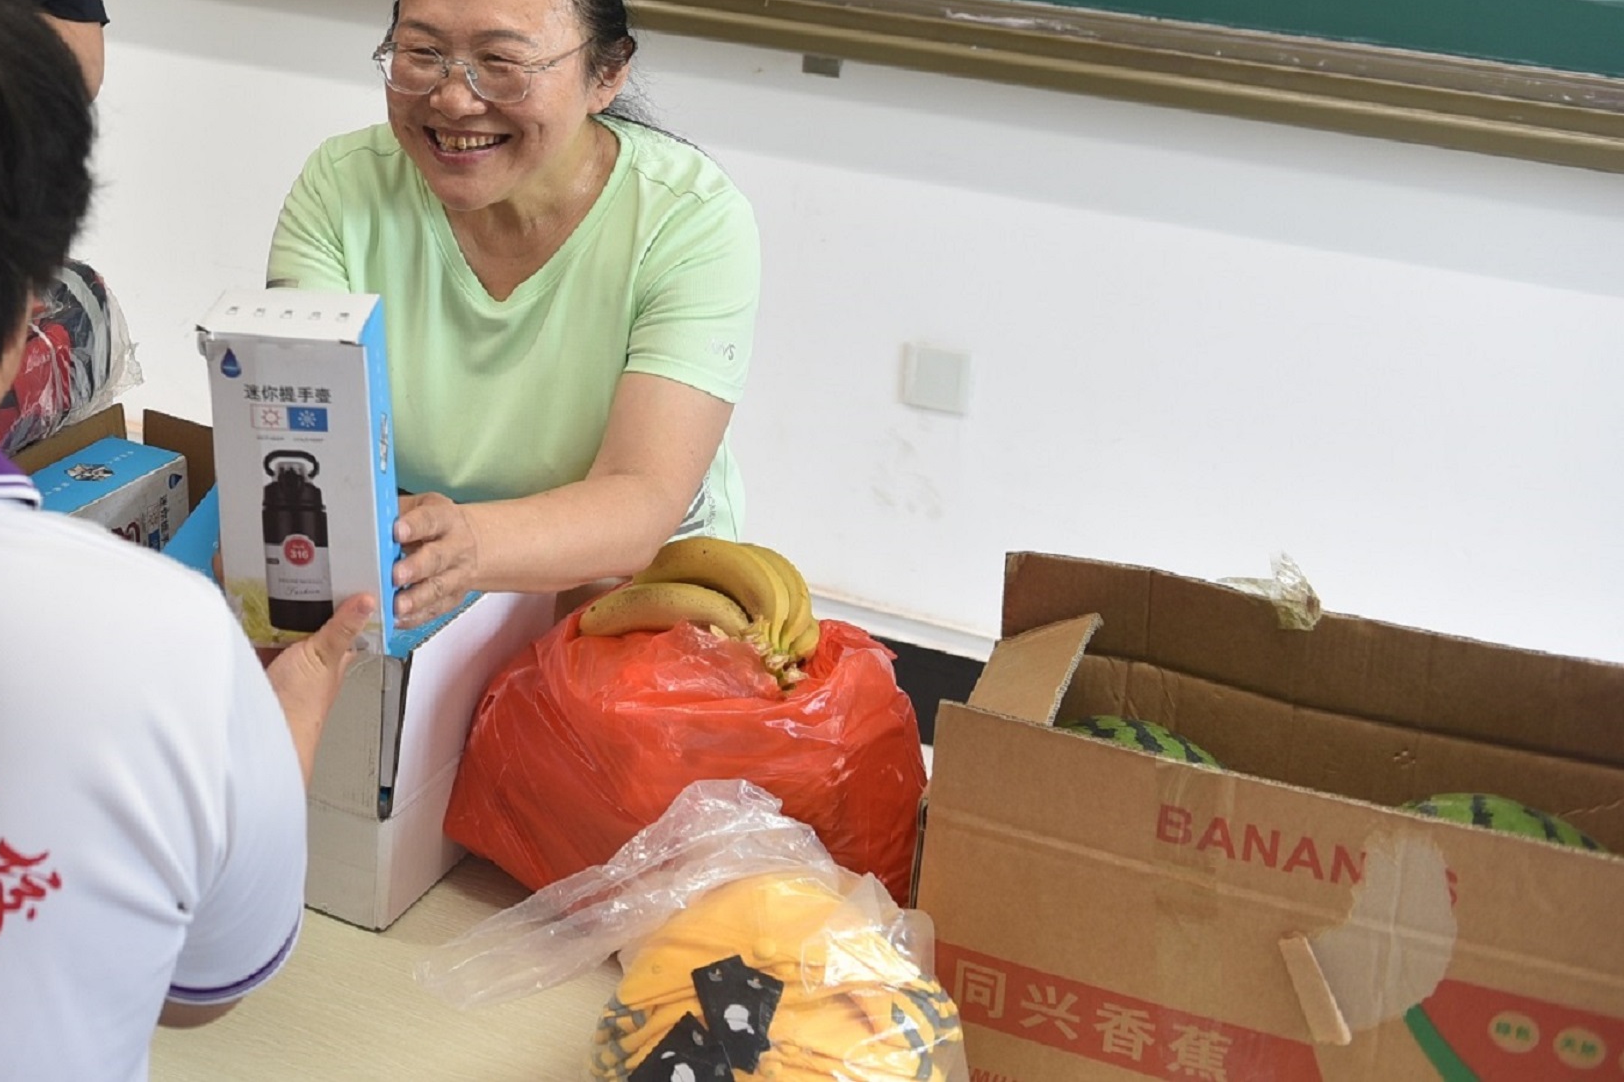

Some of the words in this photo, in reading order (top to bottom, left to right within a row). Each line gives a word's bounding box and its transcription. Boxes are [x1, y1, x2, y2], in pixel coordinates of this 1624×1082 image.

[243, 383, 332, 404] 迷你提手壶
[1155, 804, 1459, 907] BANAN
[953, 958, 1233, 1082] 同兴香蕉
